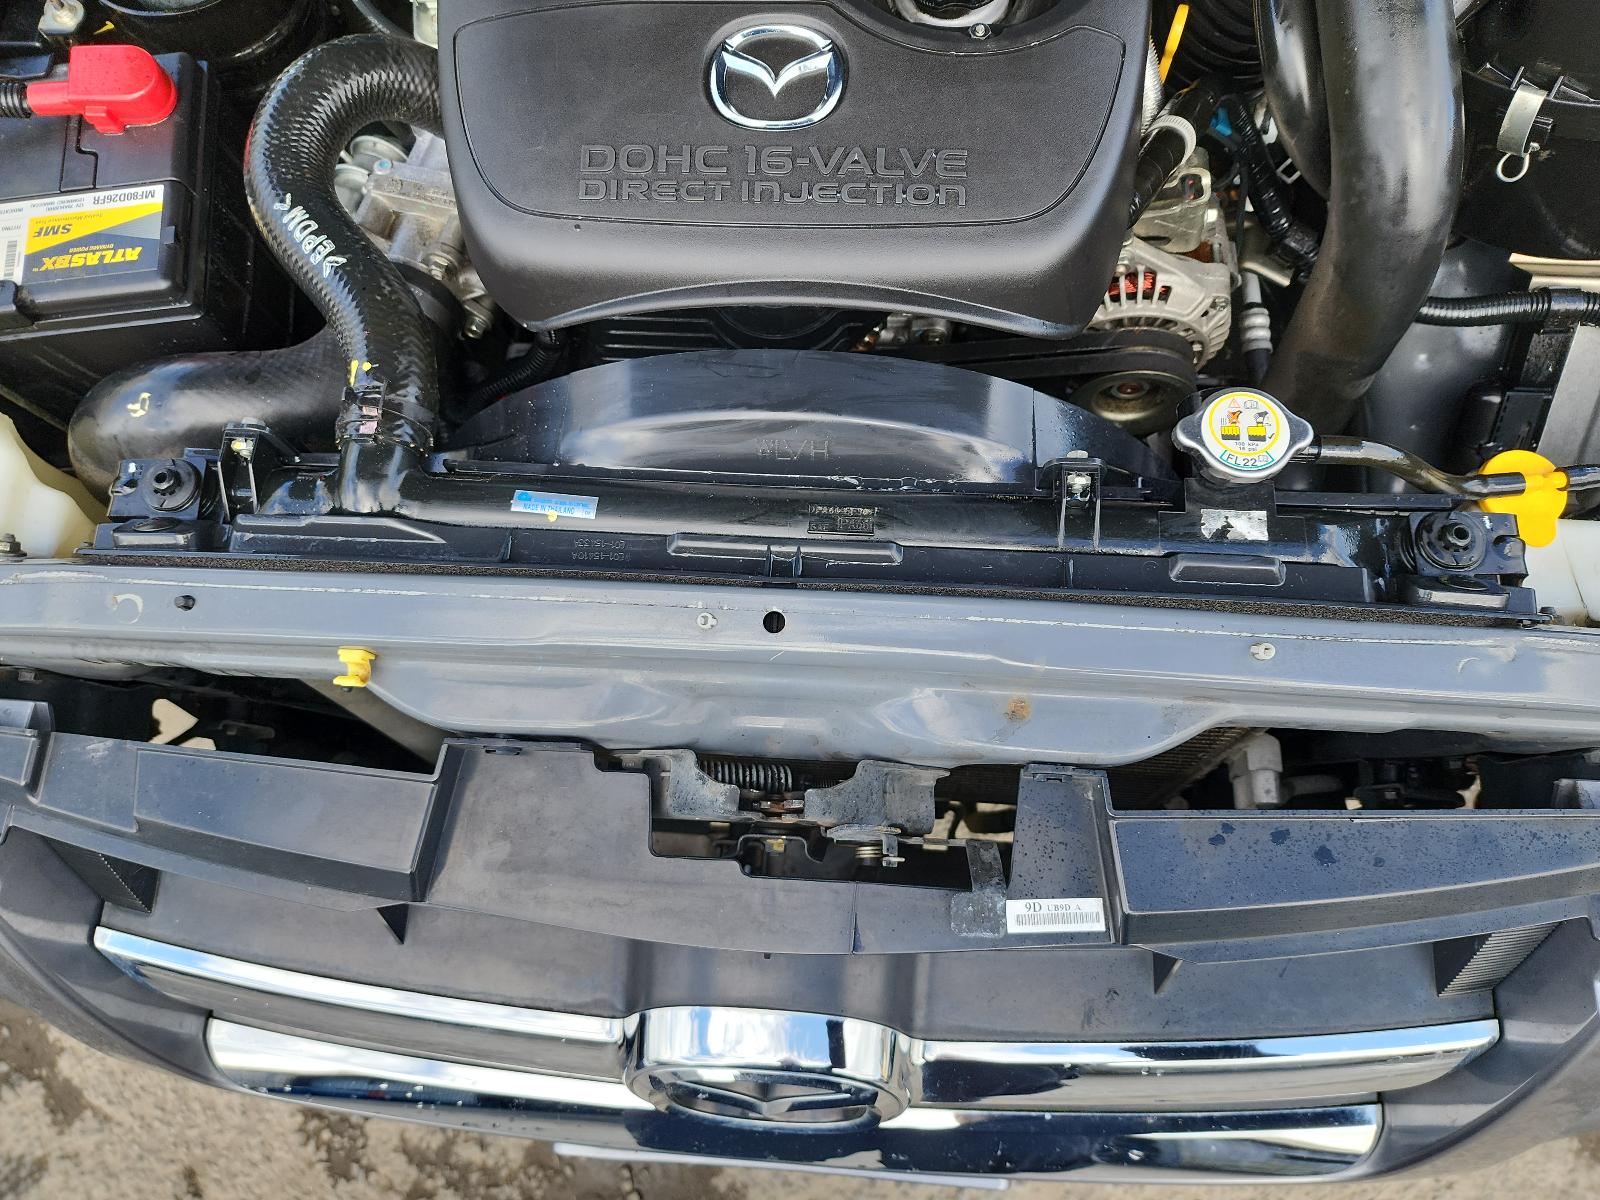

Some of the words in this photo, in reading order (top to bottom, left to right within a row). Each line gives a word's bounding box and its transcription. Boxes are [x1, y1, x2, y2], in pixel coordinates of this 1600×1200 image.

[580, 144, 729, 175] DOHC
[744, 145, 969, 178] 16-VALVE
[93, 189, 156, 205] MF80D26FR
[579, 179, 731, 201] DIRECT
[33, 223, 73, 238] SMF
[40, 247, 142, 271] ATLASBX
[1227, 454, 1257, 465] FL22
[1025, 902, 1042, 913] 9D
[1047, 904, 1071, 912] UB9D
